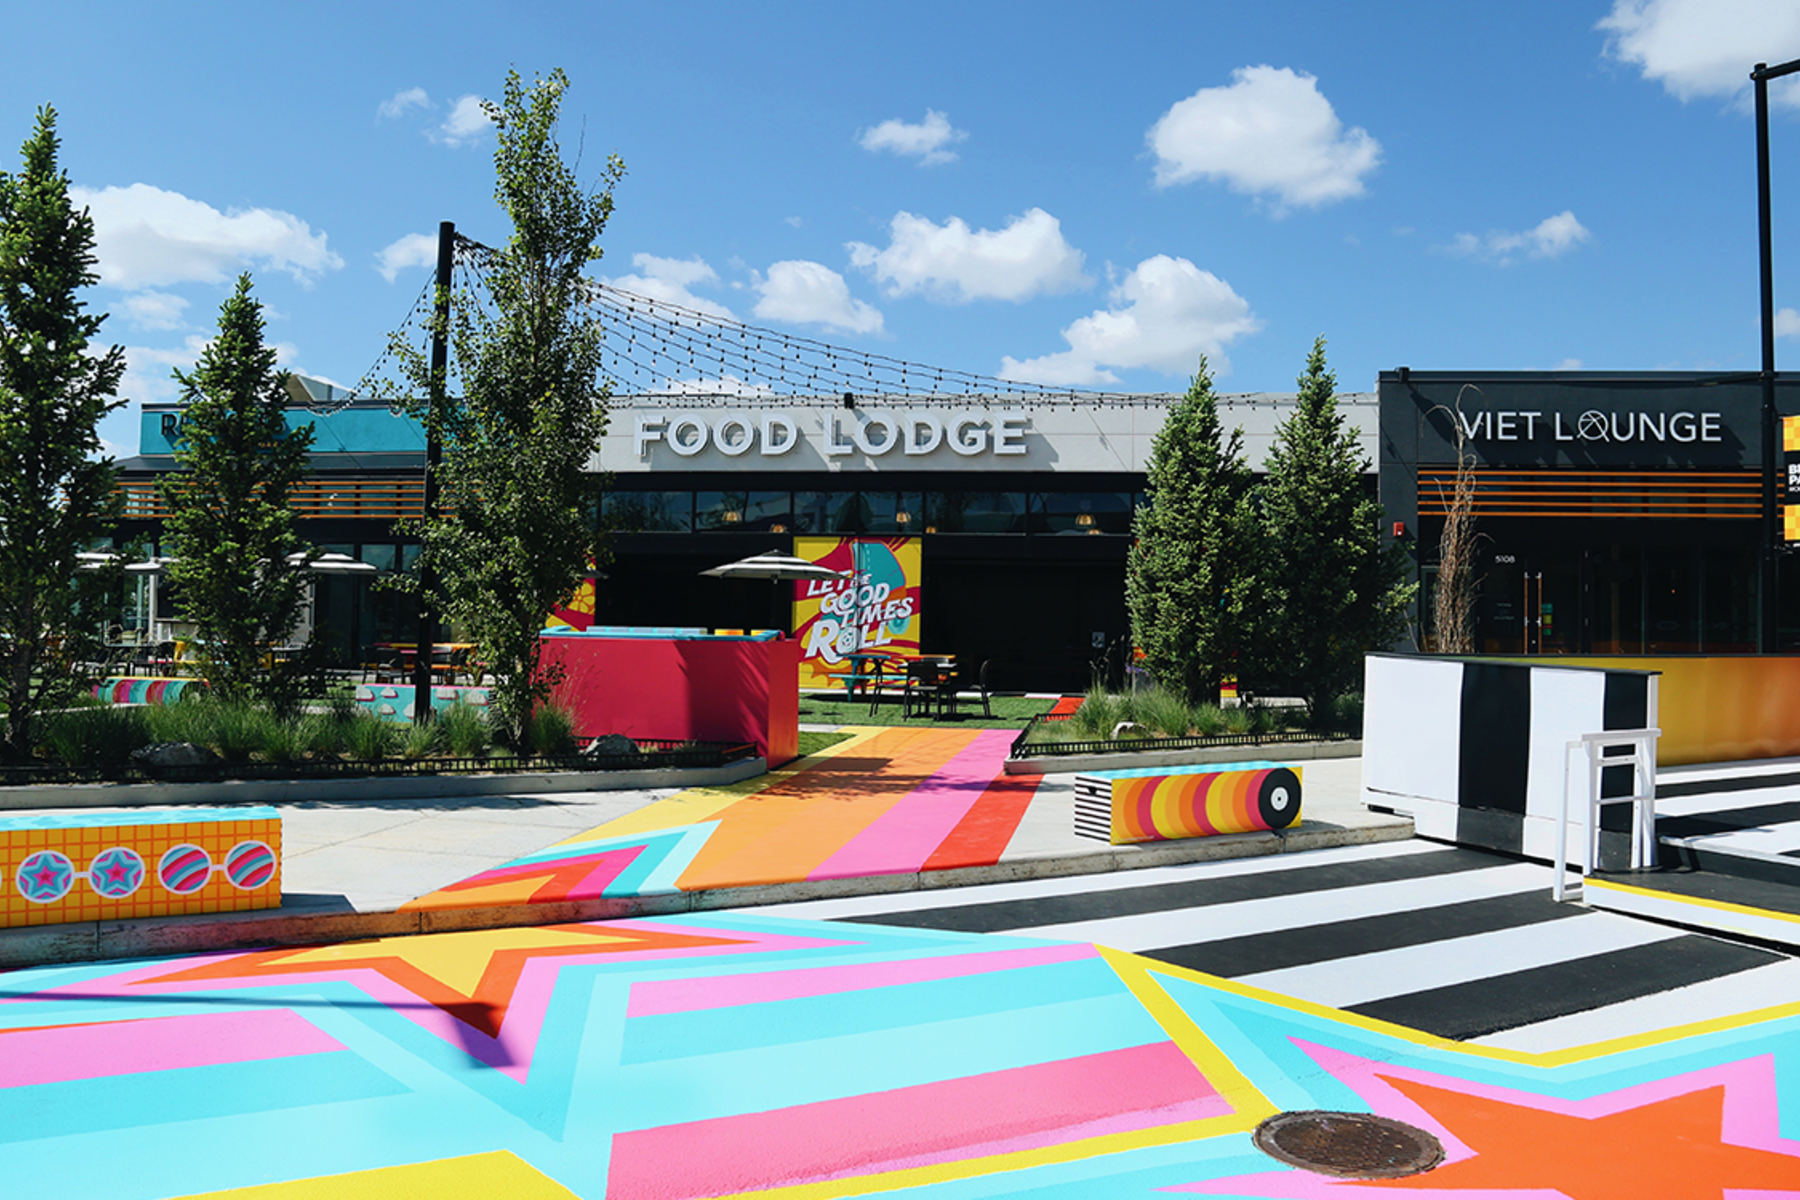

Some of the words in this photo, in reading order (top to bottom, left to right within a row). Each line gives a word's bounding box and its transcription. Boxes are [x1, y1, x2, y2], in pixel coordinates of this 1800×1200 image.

[634, 413, 798, 456] FOOD
[823, 413, 1028, 456] LODGE
[1459, 411, 1542, 440] VIET
[1555, 410, 1722, 442] LOUNGE
[806, 569, 852, 597] LET
[820, 582, 890, 614] GOOD
[833, 597, 914, 628] TIMES
[804, 619, 893, 664] ROLL
